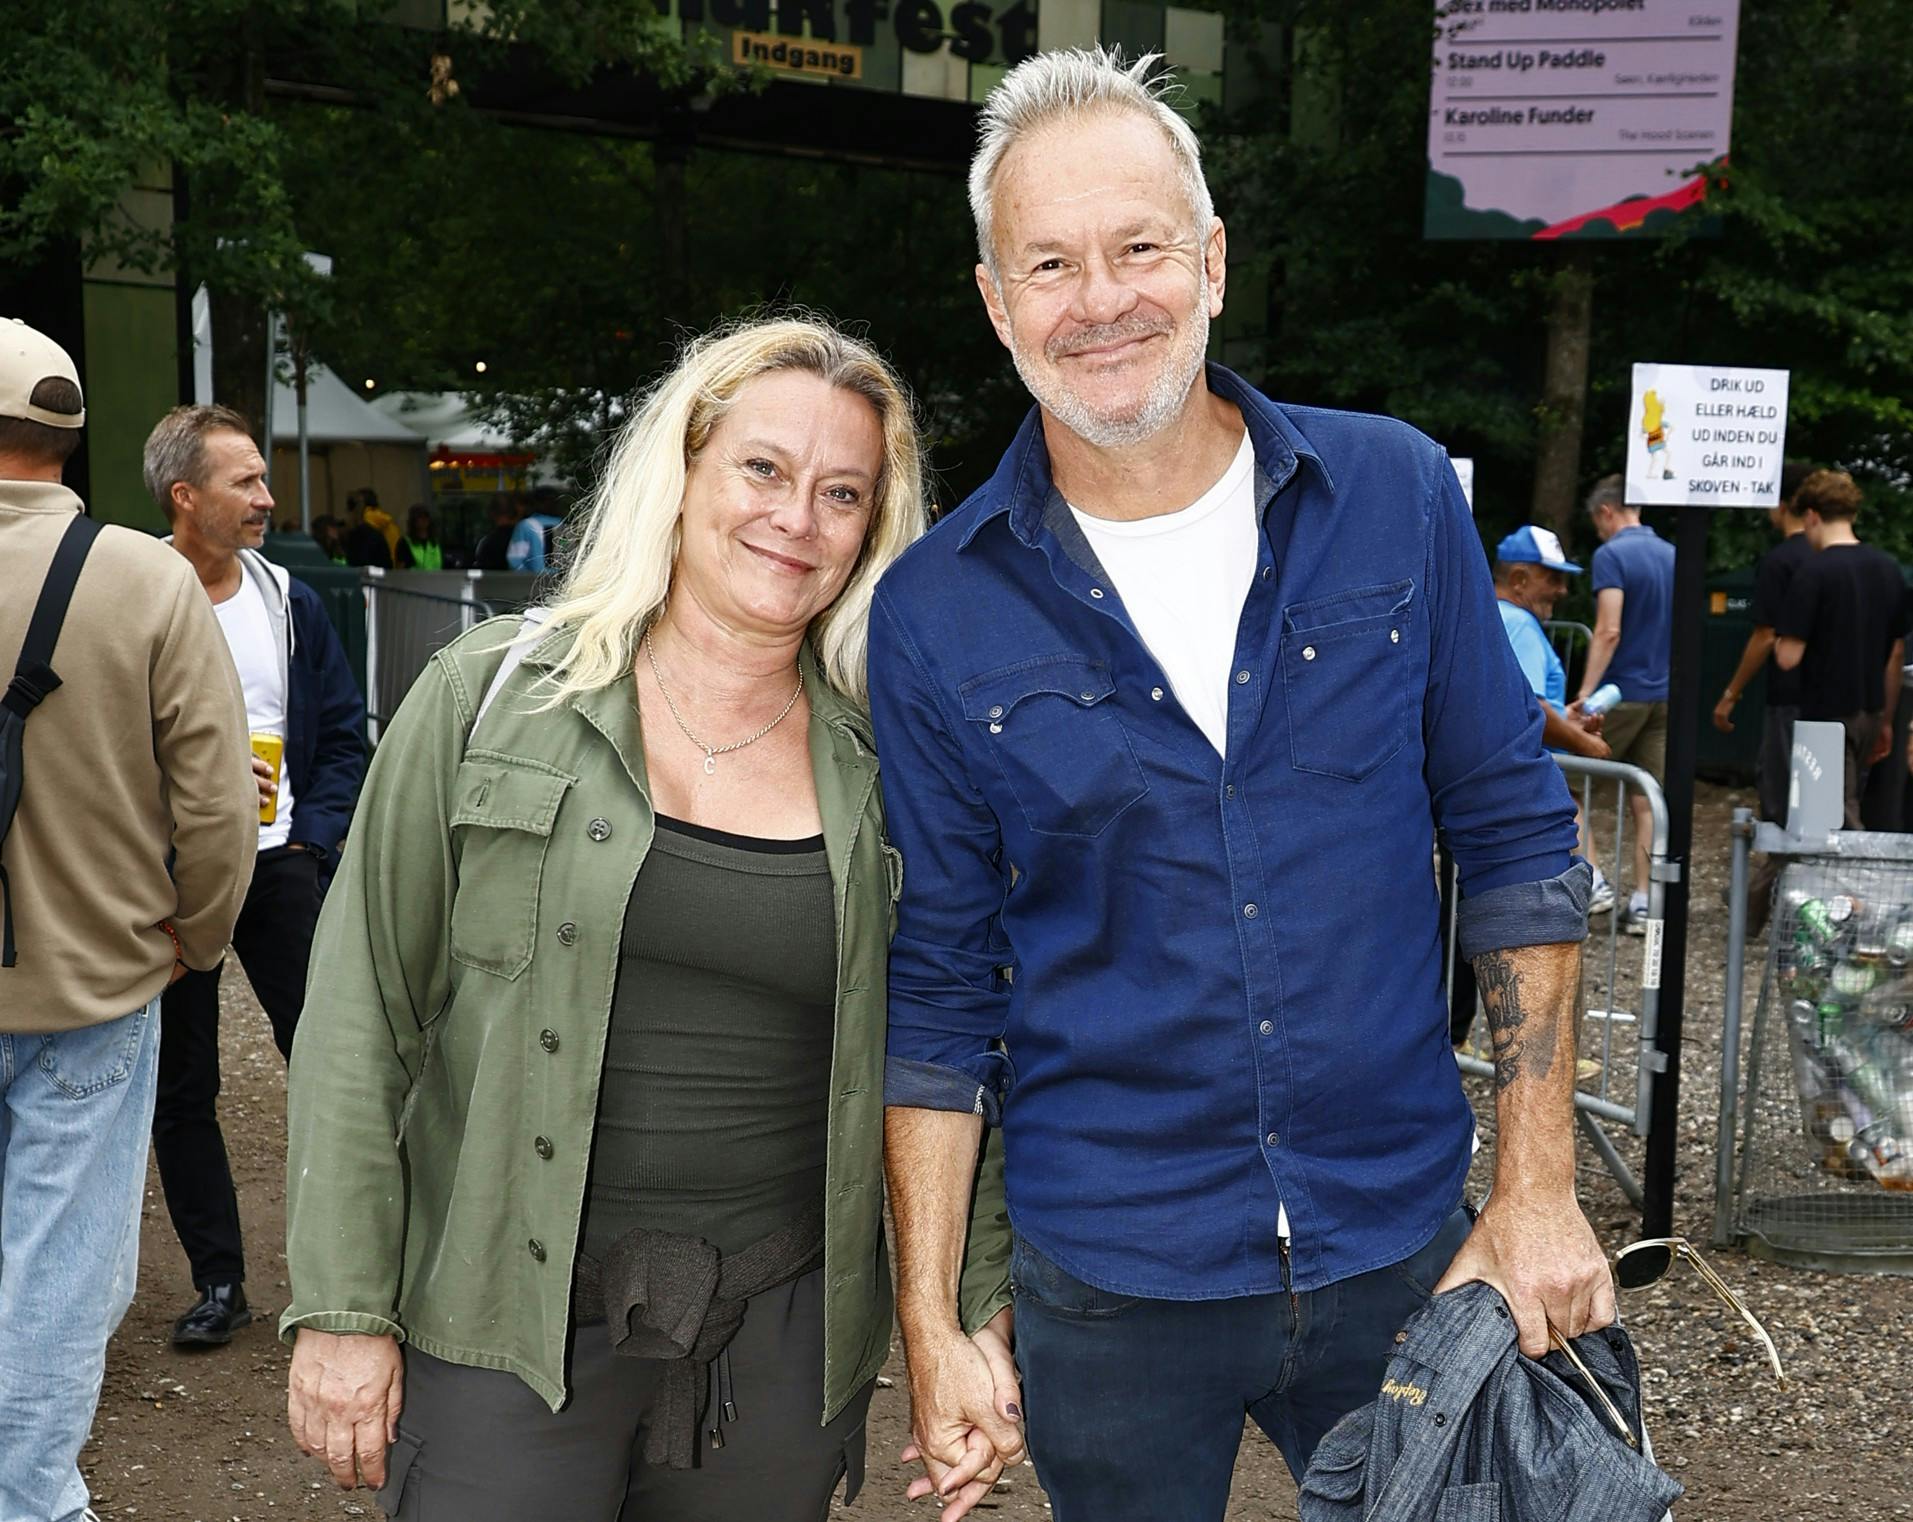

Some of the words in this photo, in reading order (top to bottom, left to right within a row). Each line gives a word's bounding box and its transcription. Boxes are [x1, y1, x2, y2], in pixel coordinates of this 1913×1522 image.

[742, 37, 854, 74] Indgang
[1448, 51, 1502, 70] Stand
[1507, 50, 1534, 71] Up
[1539, 49, 1605, 68] Paddle
[1445, 106, 1524, 125] Karoline
[1528, 106, 1595, 124] Funder
[1711, 378, 1742, 392] DRIK
[1745, 380, 1764, 393] UD
[1696, 403, 1734, 417] ELLER
[1736, 405, 1777, 419] HÆLD
[1692, 429, 1711, 442] UD
[1713, 430, 1755, 443] INDEN
[1757, 431, 1778, 444] DU
[1702, 451, 1728, 468] GÅR
[1732, 455, 1756, 468] IND
[1758, 456, 1763, 469] I
[1689, 479, 1740, 493] SKOVEN
[1751, 480, 1775, 494] TAK
[1381, 1378, 1428, 1406] Replay
